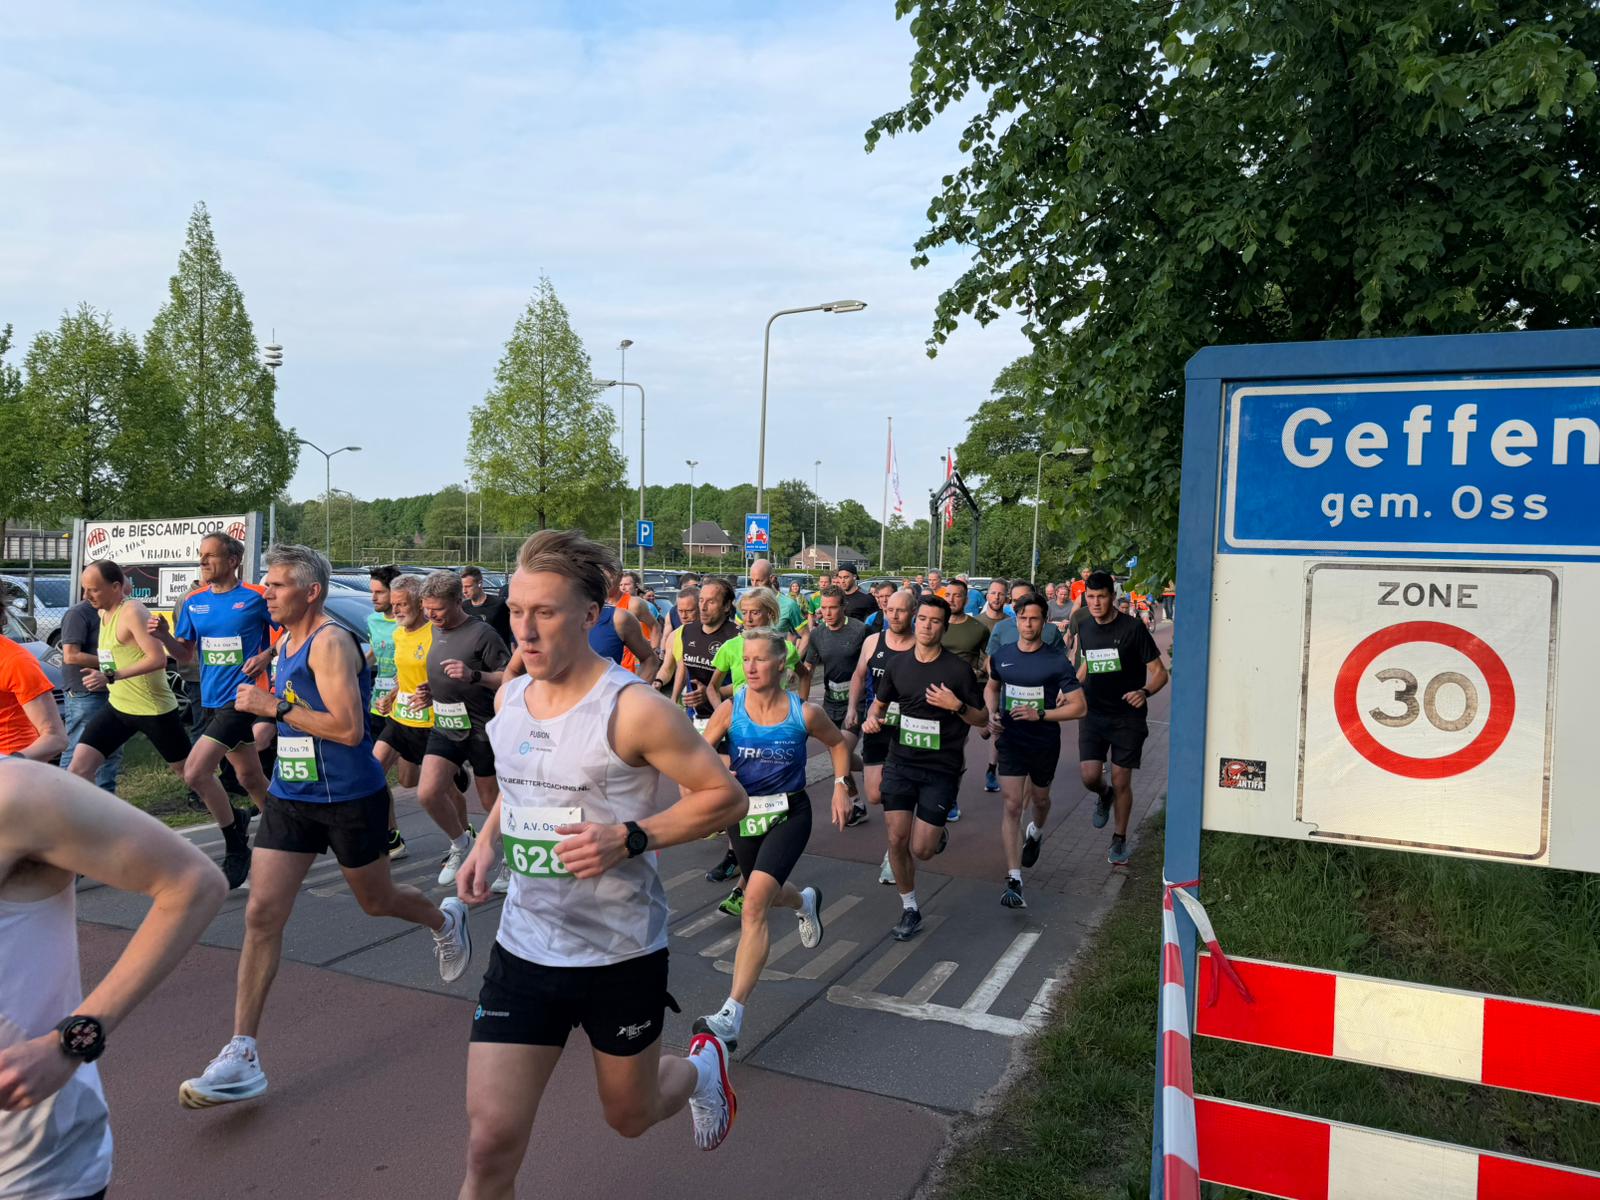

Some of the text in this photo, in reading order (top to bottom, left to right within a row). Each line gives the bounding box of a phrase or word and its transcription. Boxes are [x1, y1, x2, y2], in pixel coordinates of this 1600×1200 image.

[1281, 403, 1600, 469] Geffen
[1320, 485, 1549, 528] gem. Oss
[111, 520, 224, 538] de BIESCAMPLOOP
[641, 523, 650, 543] P
[140, 548, 182, 560] VRIJDAG
[185, 546, 191, 557] 8
[1376, 581, 1479, 609] ZONE
[207, 651, 238, 665] 624
[1092, 660, 1116, 672] 673
[1368, 667, 1479, 733] 30
[438, 716, 464, 729] 605
[529, 730, 550, 740] FUSION
[904, 732, 932, 747] 611
[737, 746, 796, 760] TRIOSS
[1237, 779, 1264, 789] ANTIFA
[523, 822, 541, 831] A.V.
[512, 843, 569, 874] 628
